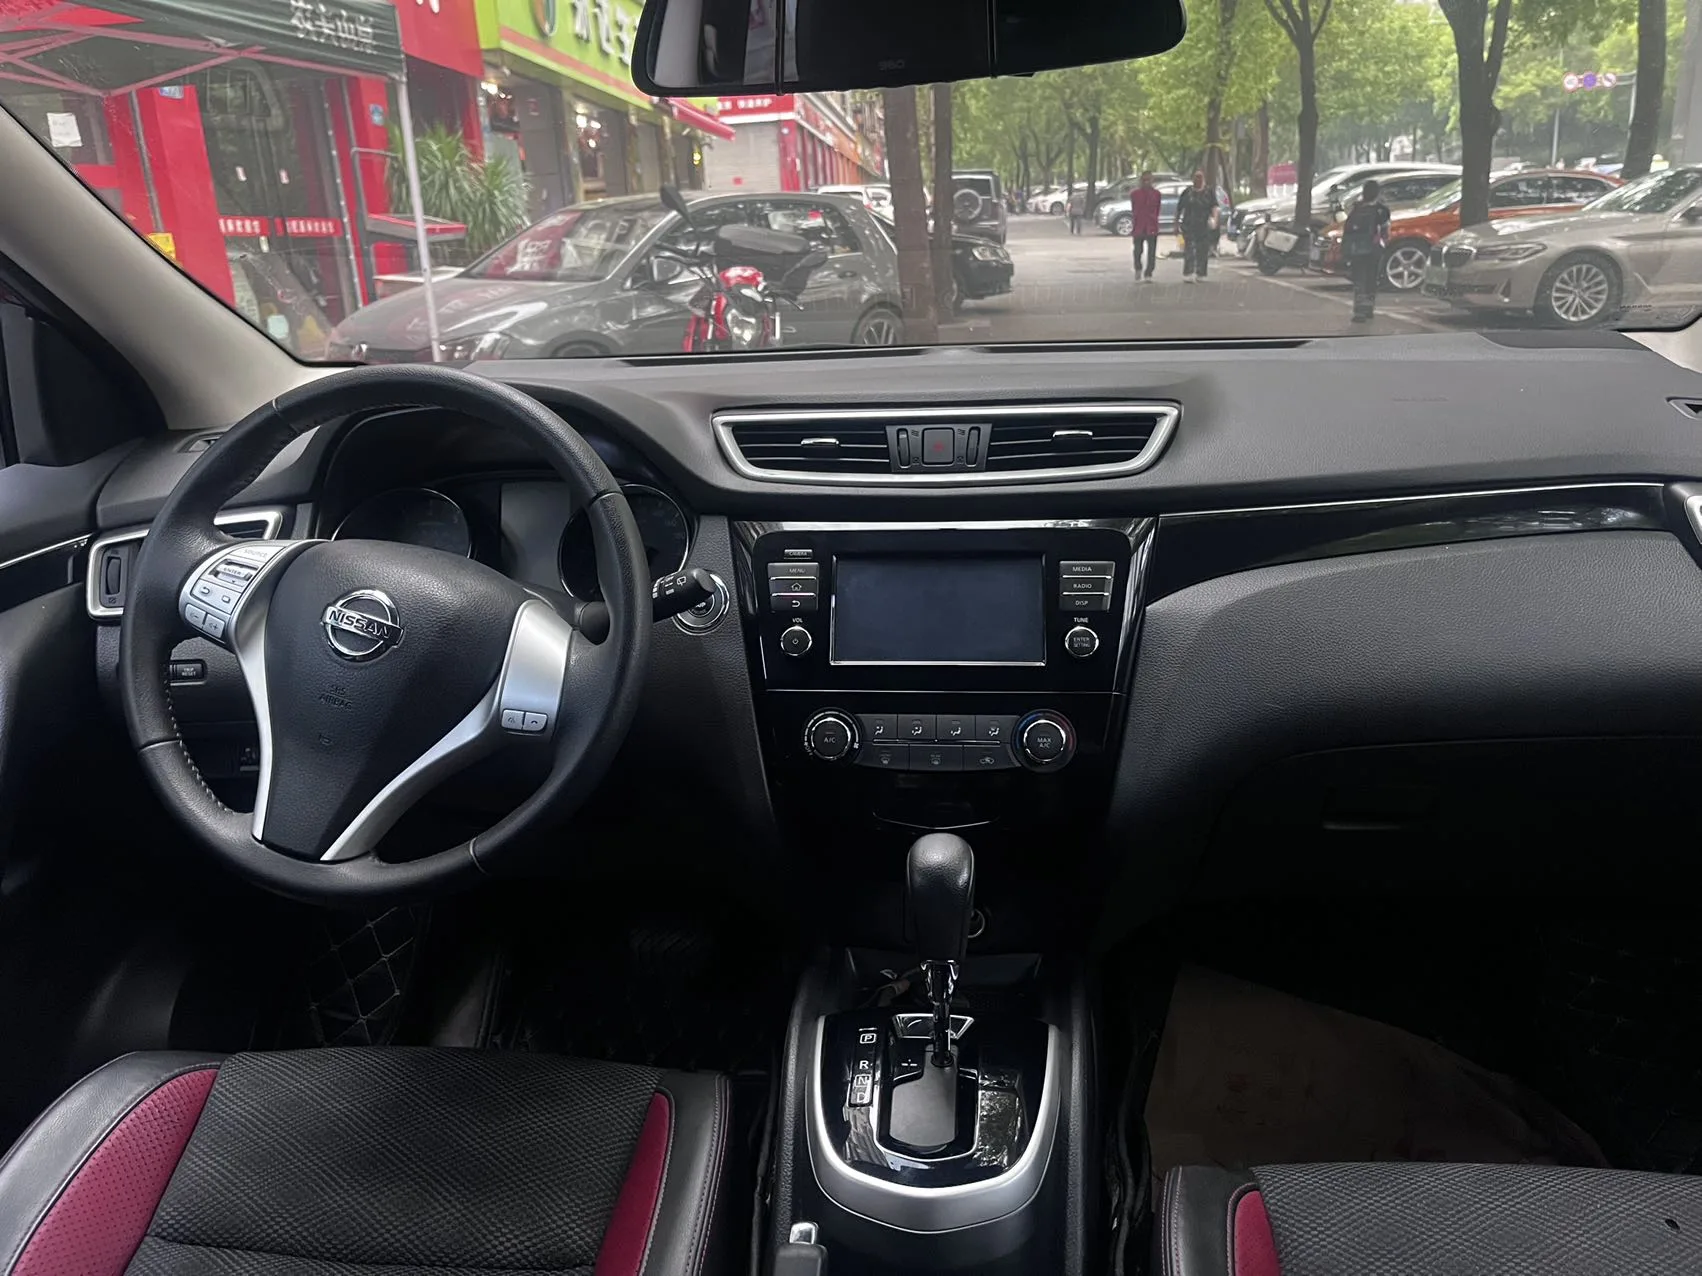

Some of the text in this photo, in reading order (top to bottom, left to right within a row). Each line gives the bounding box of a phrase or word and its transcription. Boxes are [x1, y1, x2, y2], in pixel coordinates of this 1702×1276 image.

[328, 609, 391, 639] NISSAN
[859, 1060, 869, 1069] R
[858, 1076, 868, 1085] N
[856, 1092, 867, 1103] D
